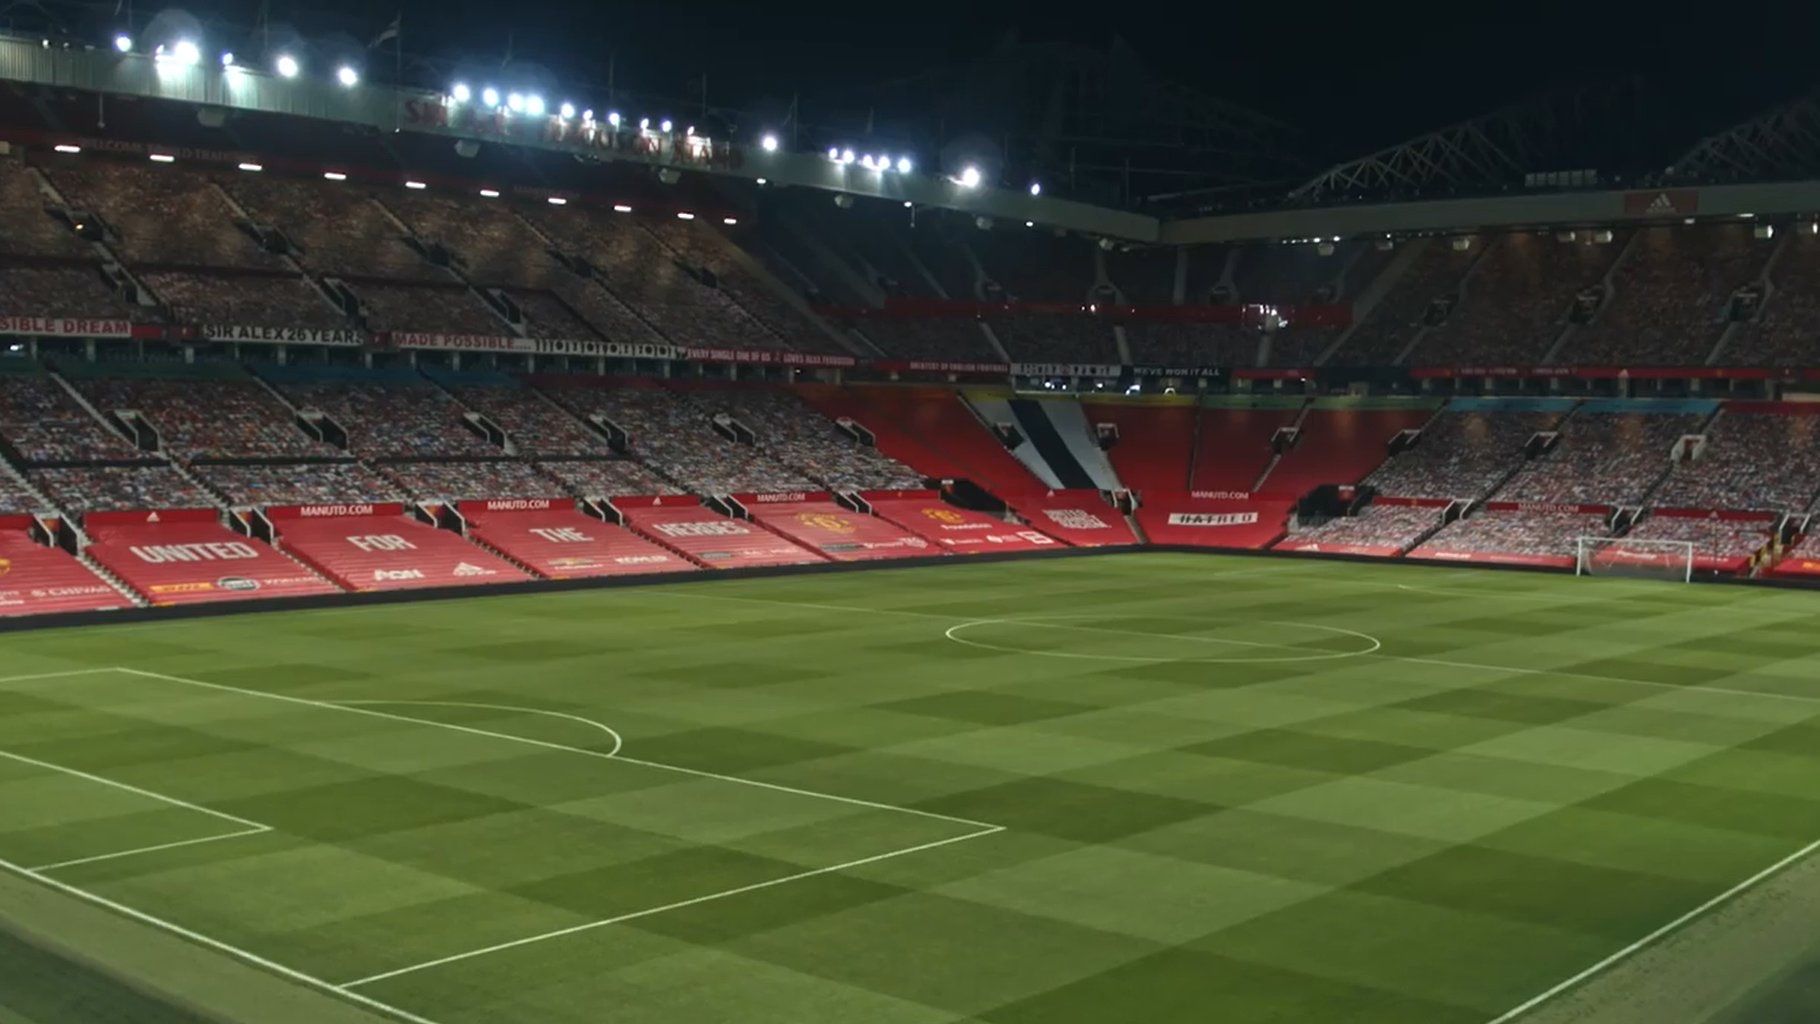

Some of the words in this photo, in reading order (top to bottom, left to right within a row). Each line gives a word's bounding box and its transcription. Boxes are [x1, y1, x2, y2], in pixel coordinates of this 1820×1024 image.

[63, 320, 128, 334] DREAM
[205, 324, 234, 338] SIR
[238, 326, 284, 340] ALEX
[306, 329, 364, 344] YEARS
[394, 333, 439, 346] MADE
[1201, 367, 1220, 376] ALL
[300, 504, 373, 517] MANUTD.COM
[487, 499, 550, 511] MANUTD.COM
[528, 527, 594, 543] THE
[346, 534, 419, 552] FOR
[129, 541, 259, 564] UNITED
